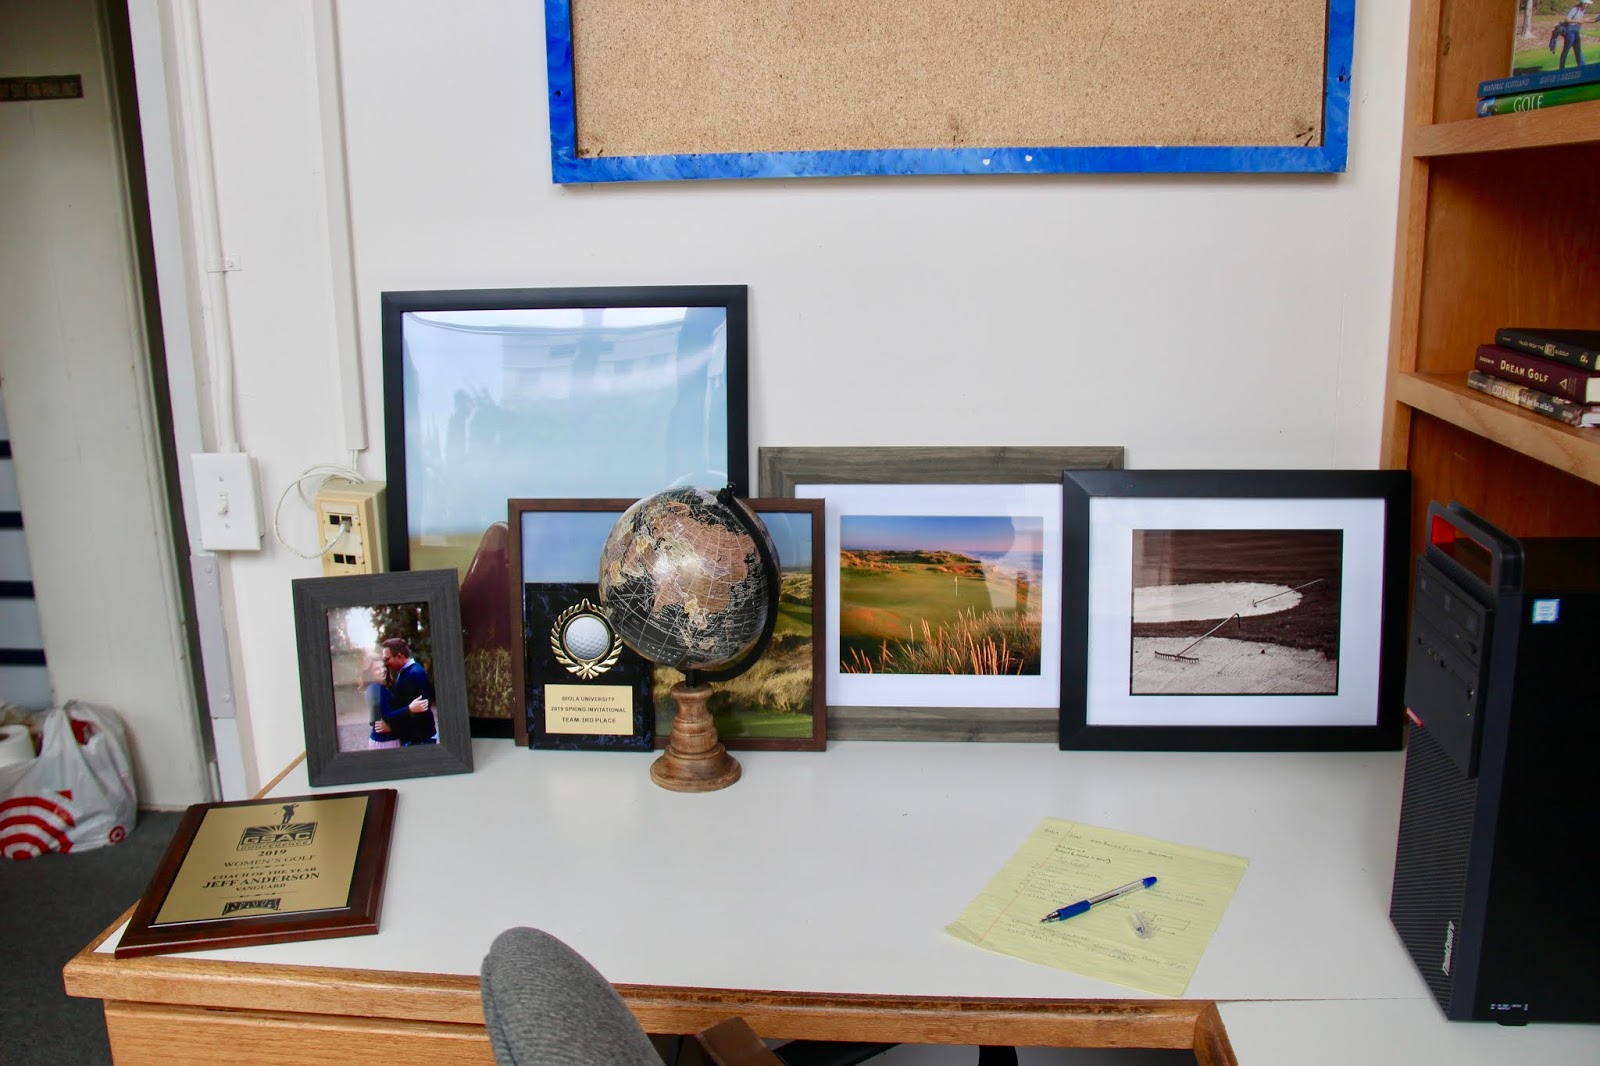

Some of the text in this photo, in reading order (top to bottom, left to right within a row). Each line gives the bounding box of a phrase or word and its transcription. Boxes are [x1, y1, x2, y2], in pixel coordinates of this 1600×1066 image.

[1513, 95, 1544, 113] GOLF
[1500, 360, 1549, 383] DREAM GOLF
[243, 832, 311, 845] GSAC
[224, 858, 281, 868] WOMEN'S
[202, 872, 320, 889] JEFF ANDERSON
[212, 872, 249, 880] COACH
[235, 883, 286, 892] VANGUARD
